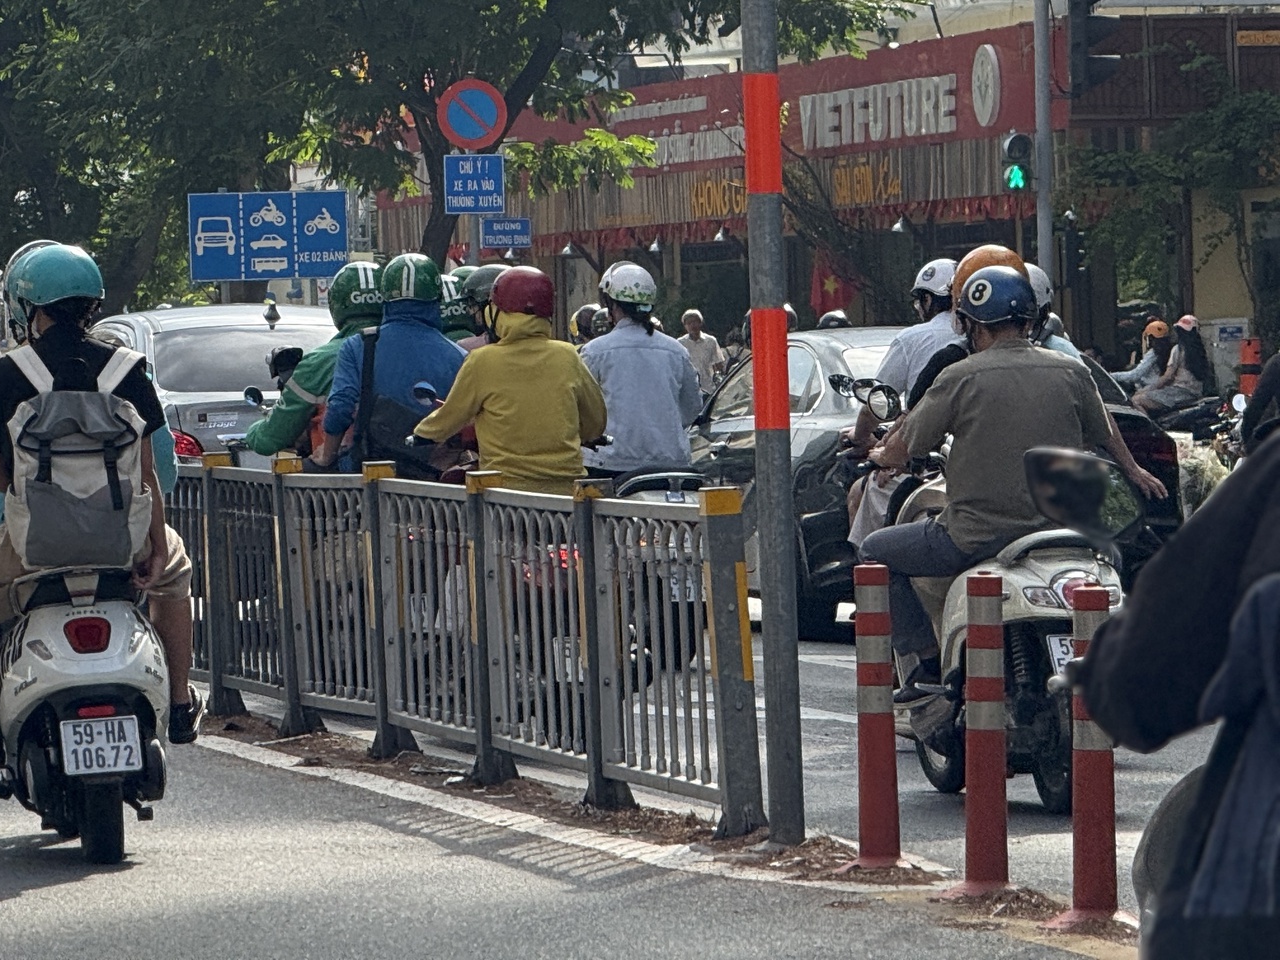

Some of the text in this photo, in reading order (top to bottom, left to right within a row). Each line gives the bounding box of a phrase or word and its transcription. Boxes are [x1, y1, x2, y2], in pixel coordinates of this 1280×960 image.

[799, 74, 957, 150] VIETFUTURE
[459, 157, 473, 174] CHÚ
[454, 176, 495, 191] XE RA VÀO
[478, 192, 502, 207] XUYÊN
[691, 172, 730, 219] KHÔNG
[493, 221, 521, 230] ĐƯỜNG
[298, 248, 347, 262] XE 02 BÁNH
[350, 291, 384, 304] Grab
[971, 282, 987, 301] 8
[72, 721, 127, 746] 59-HA
[71, 745, 135, 770] 106.72
